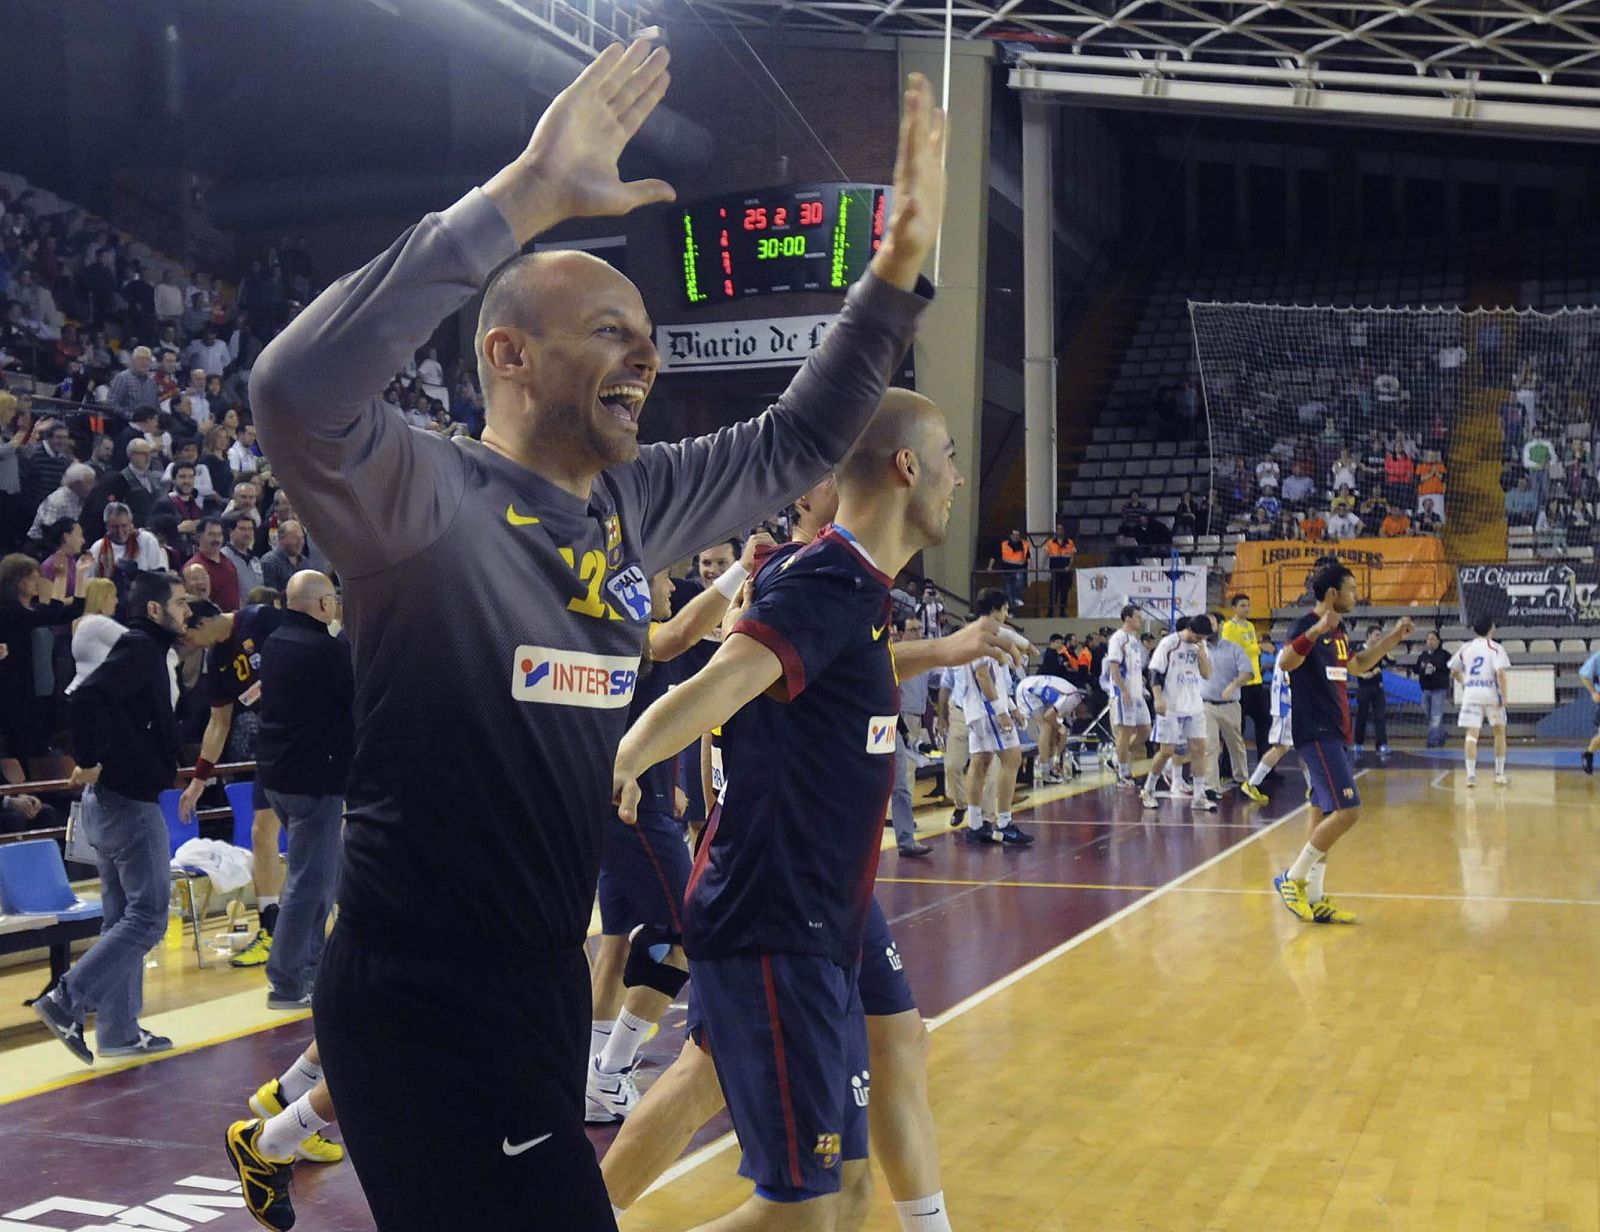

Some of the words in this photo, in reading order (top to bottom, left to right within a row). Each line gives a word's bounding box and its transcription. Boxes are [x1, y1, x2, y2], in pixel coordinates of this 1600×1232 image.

[743, 208, 767, 230] 25
[774, 207, 787, 226] 2
[800, 202, 823, 225] 30
[757, 235, 806, 259] 30:00
[668, 328, 757, 359] Diario
[769, 325, 798, 353] de
[1460, 567, 1485, 583] El
[1484, 566, 1554, 589] Cigarral
[1334, 638, 1348, 660] 11
[233, 654, 250, 681] 27
[1470, 656, 1484, 676] 2
